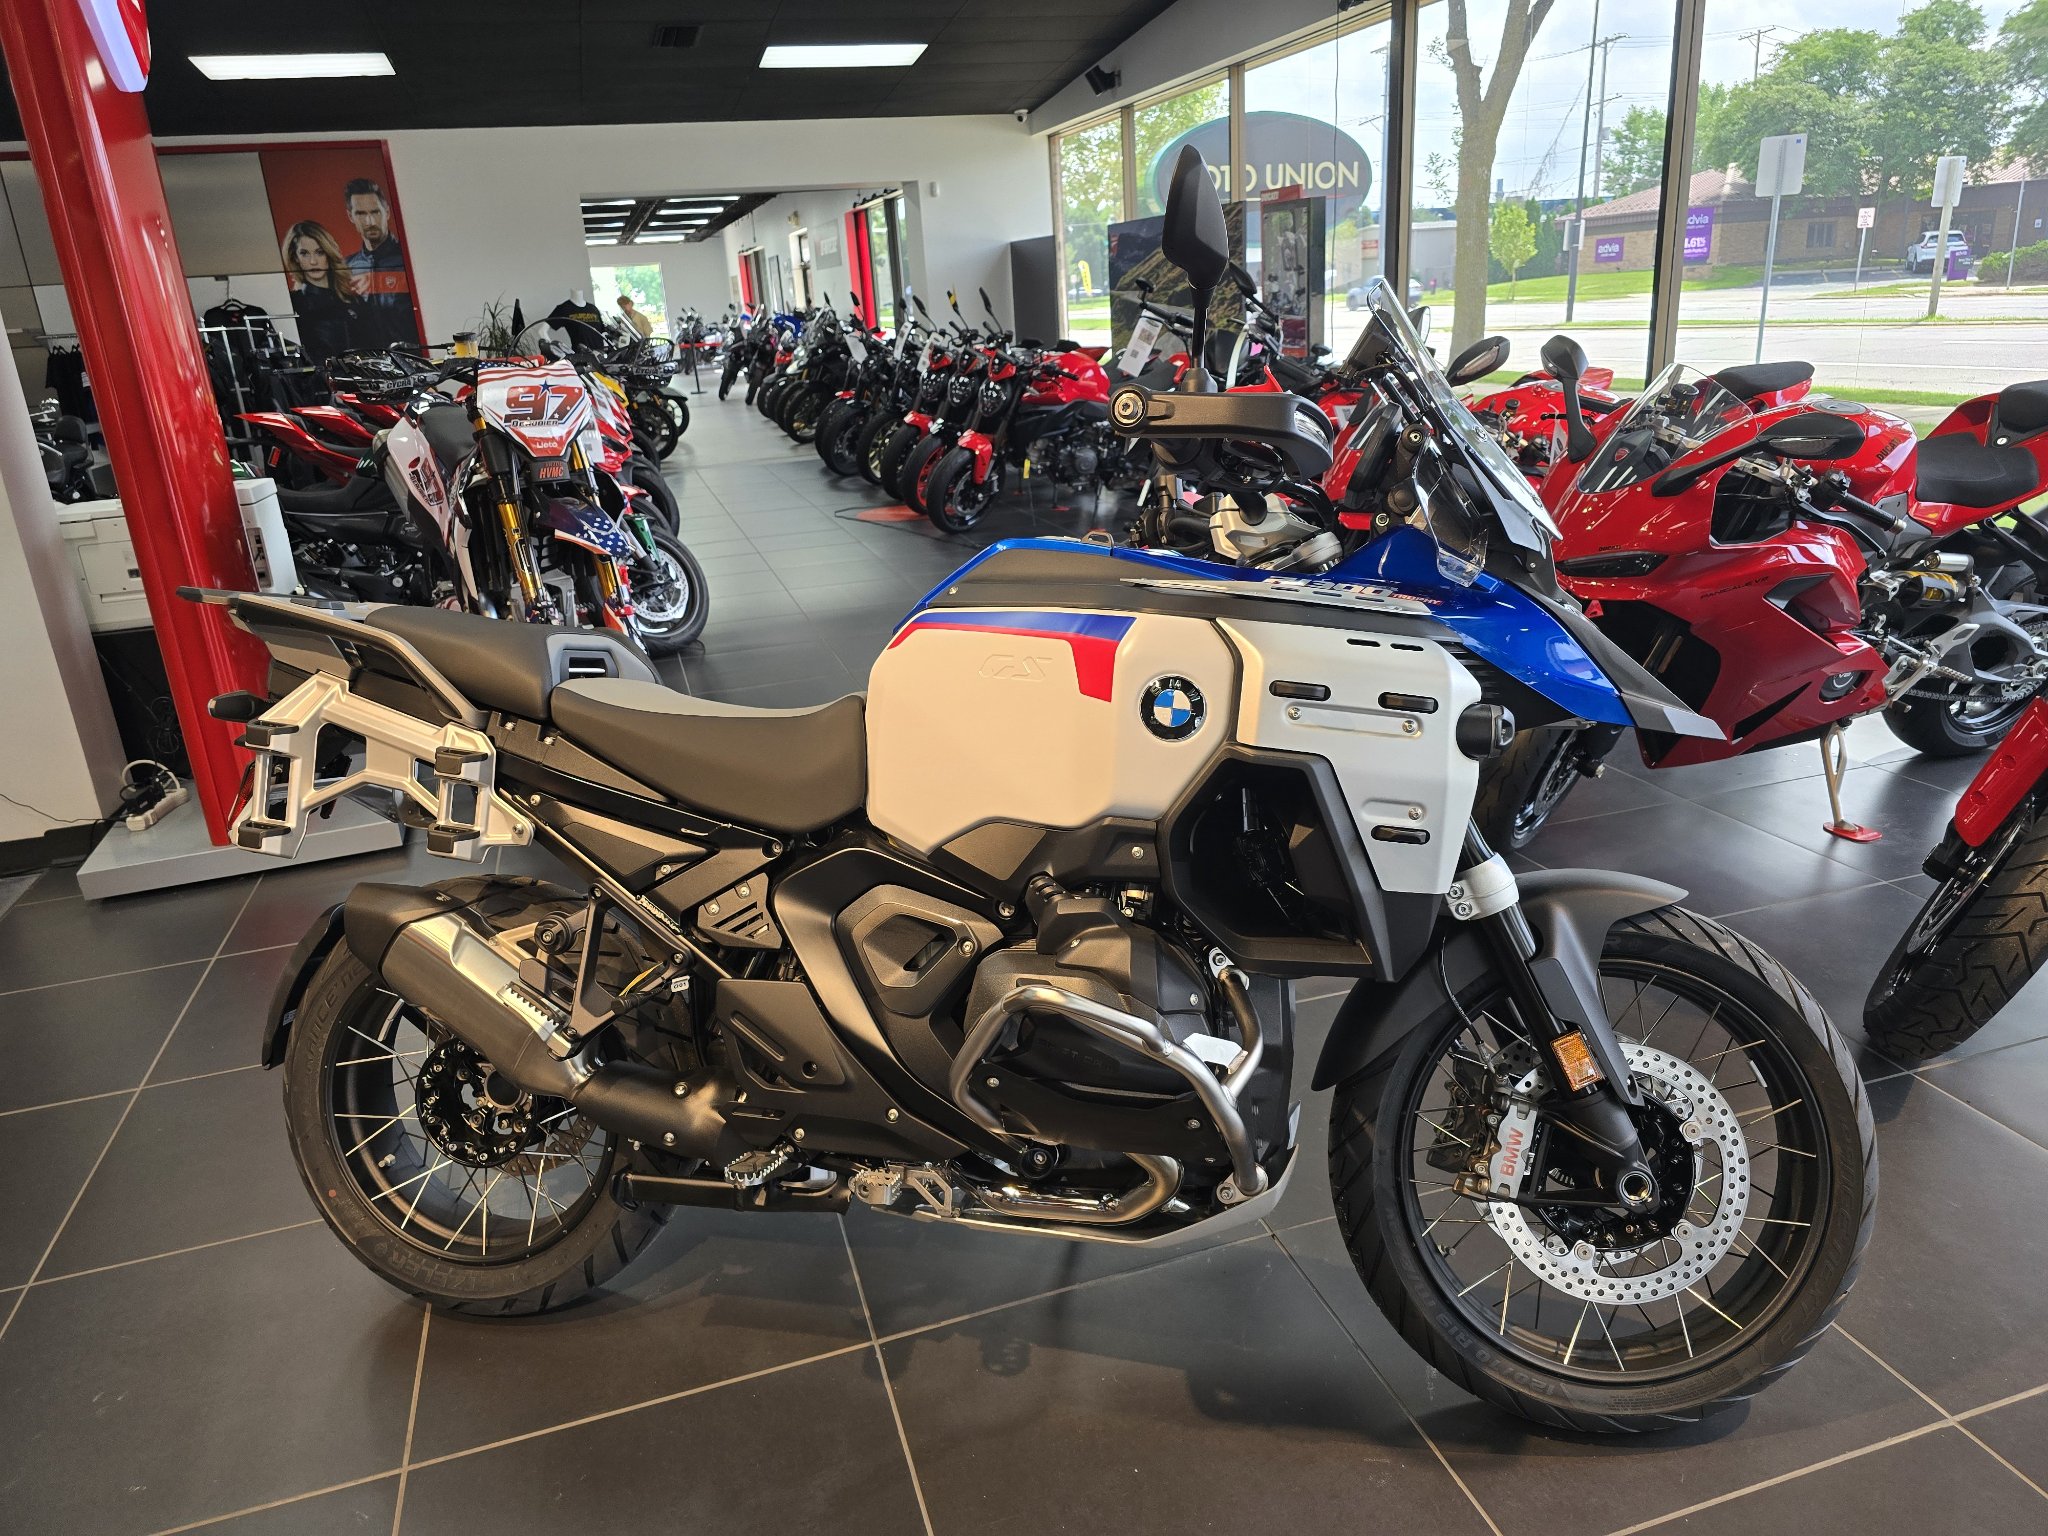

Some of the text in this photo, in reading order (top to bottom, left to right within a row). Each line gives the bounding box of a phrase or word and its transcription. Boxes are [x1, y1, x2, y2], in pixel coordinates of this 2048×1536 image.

[1265, 161, 1359, 190] UNION
[1687, 214, 1709, 224] dvia
[504, 386, 585, 423] 97
[1150, 678, 1201, 702] BMW
[1500, 1127, 1524, 1177] BMW
